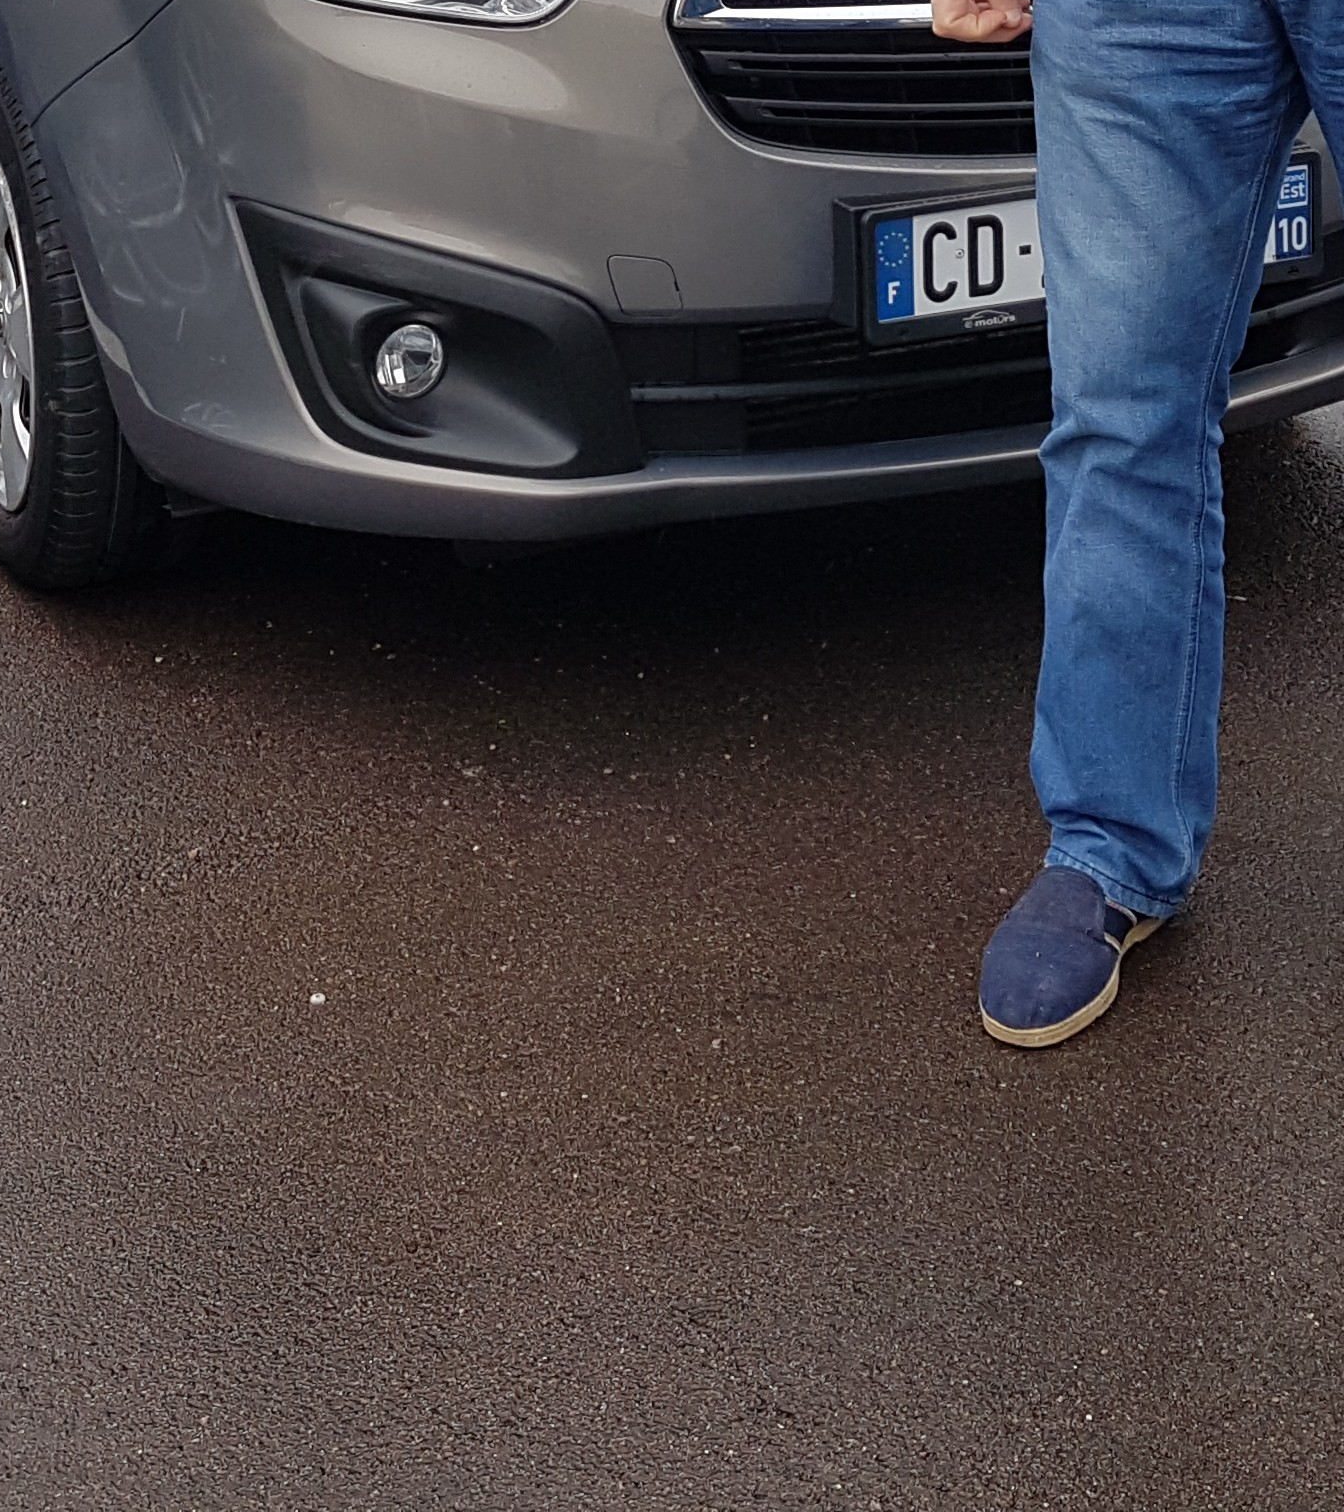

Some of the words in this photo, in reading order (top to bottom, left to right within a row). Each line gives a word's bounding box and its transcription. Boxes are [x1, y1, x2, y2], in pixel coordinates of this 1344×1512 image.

[1283, 172, 1306, 183] rand
[1280, 182, 1306, 199] Est
[1278, 216, 1307, 253] 10
[923, 214, 1045, 303] CD-
[888, 281, 901, 304] F
